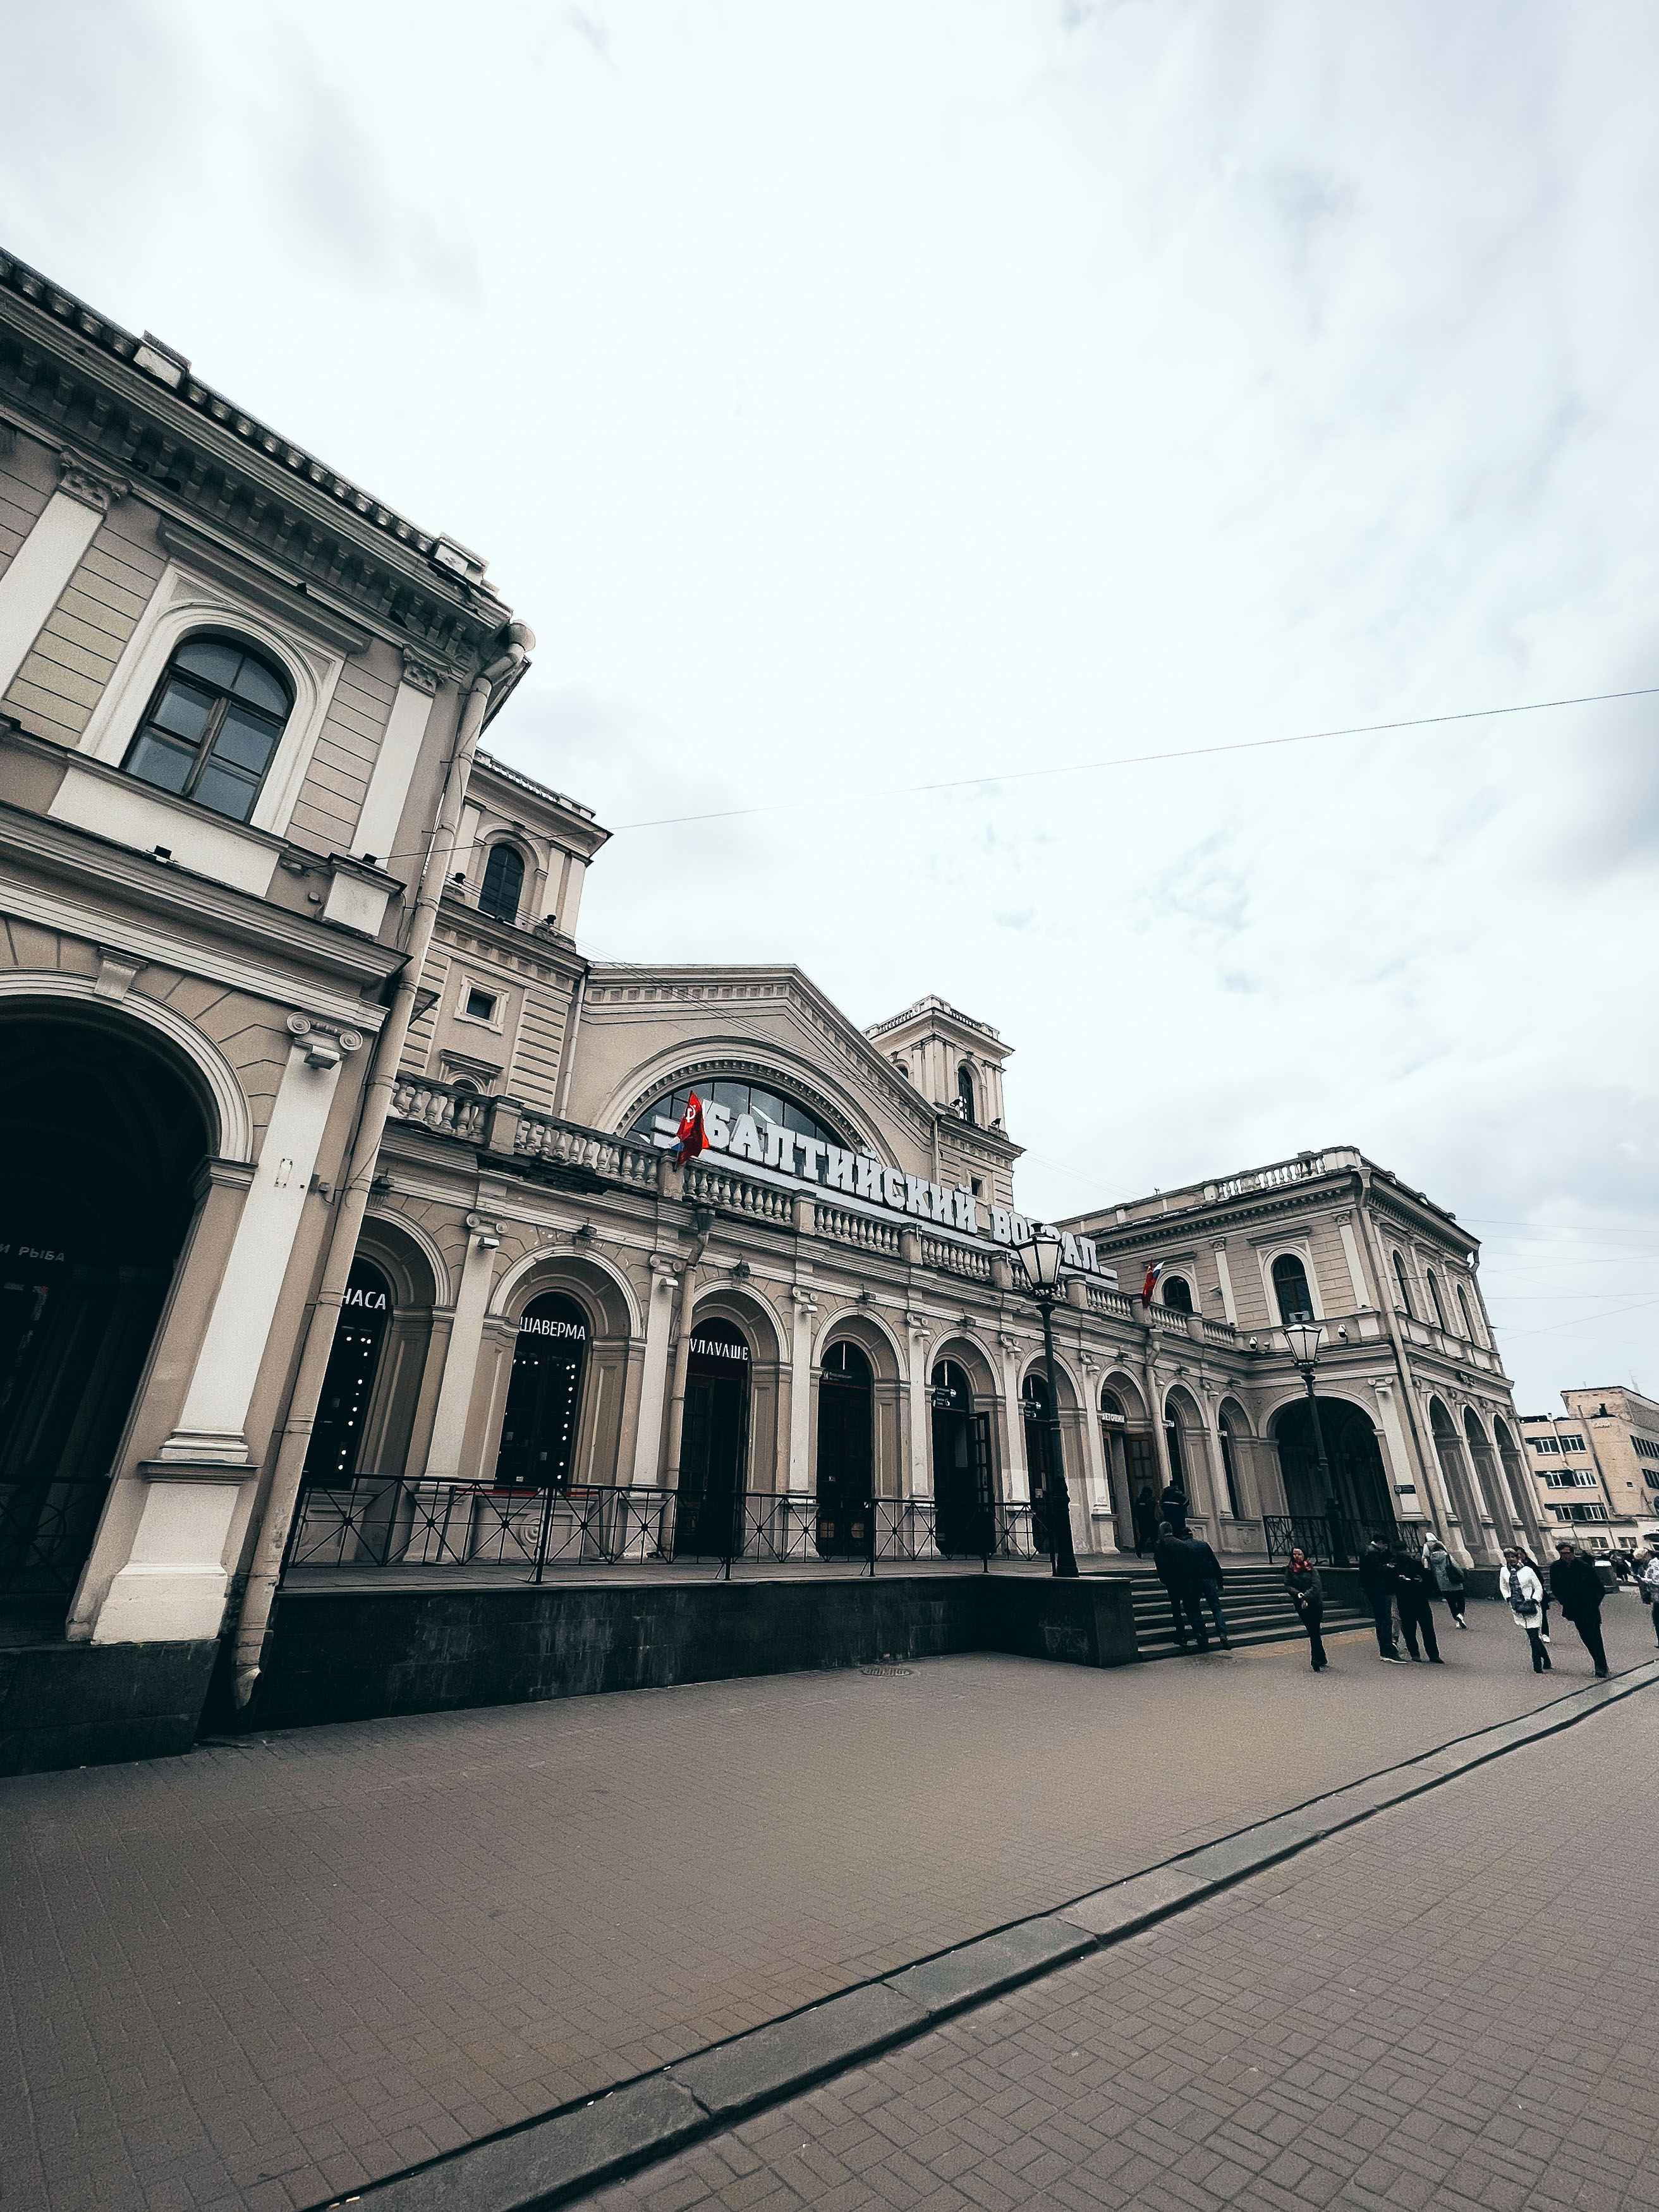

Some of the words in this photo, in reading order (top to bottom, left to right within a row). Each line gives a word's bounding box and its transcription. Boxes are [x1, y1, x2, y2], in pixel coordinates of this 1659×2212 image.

[703, 1098, 978, 1234] БАЛТИЙСКИЙ
[18, 1246, 64, 1262] РЫБА
[520, 1316, 585, 1340] ШАВЕРМА
